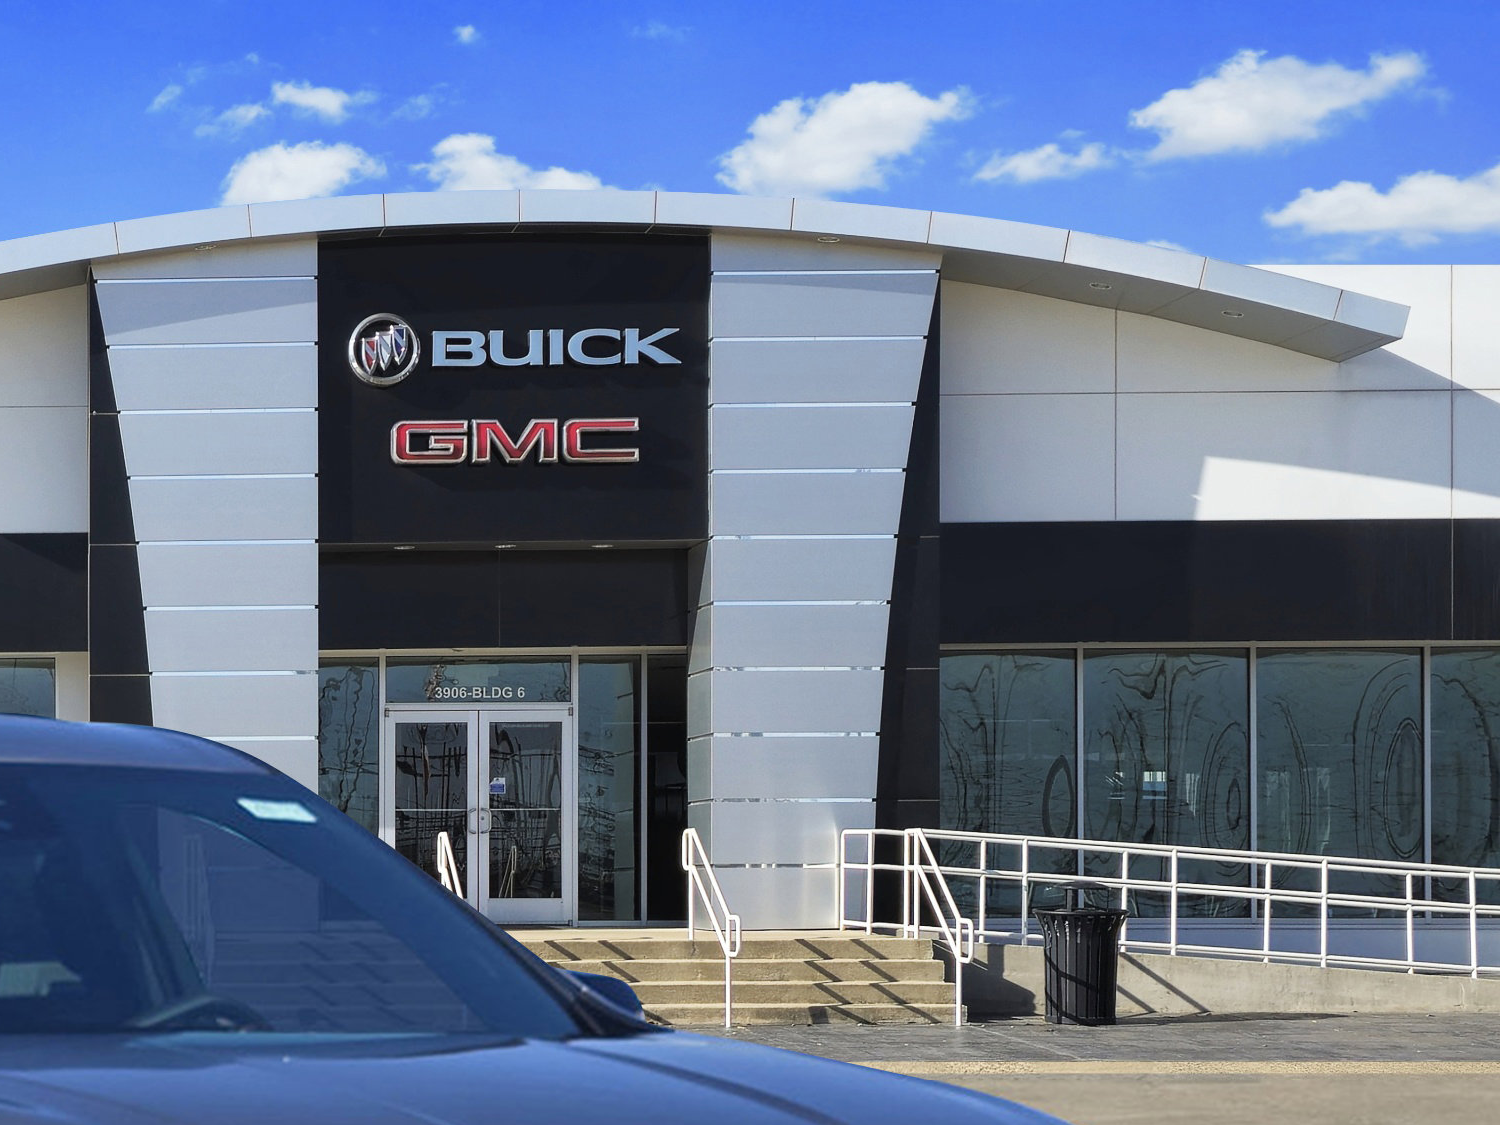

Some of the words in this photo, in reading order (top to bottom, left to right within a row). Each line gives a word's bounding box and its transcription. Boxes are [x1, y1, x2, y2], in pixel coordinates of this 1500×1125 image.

[431, 327, 682, 368] BUICK
[389, 416, 640, 465] GMC
[434, 686, 513, 699] 3906-BLDG
[517, 686, 526, 699] 6
